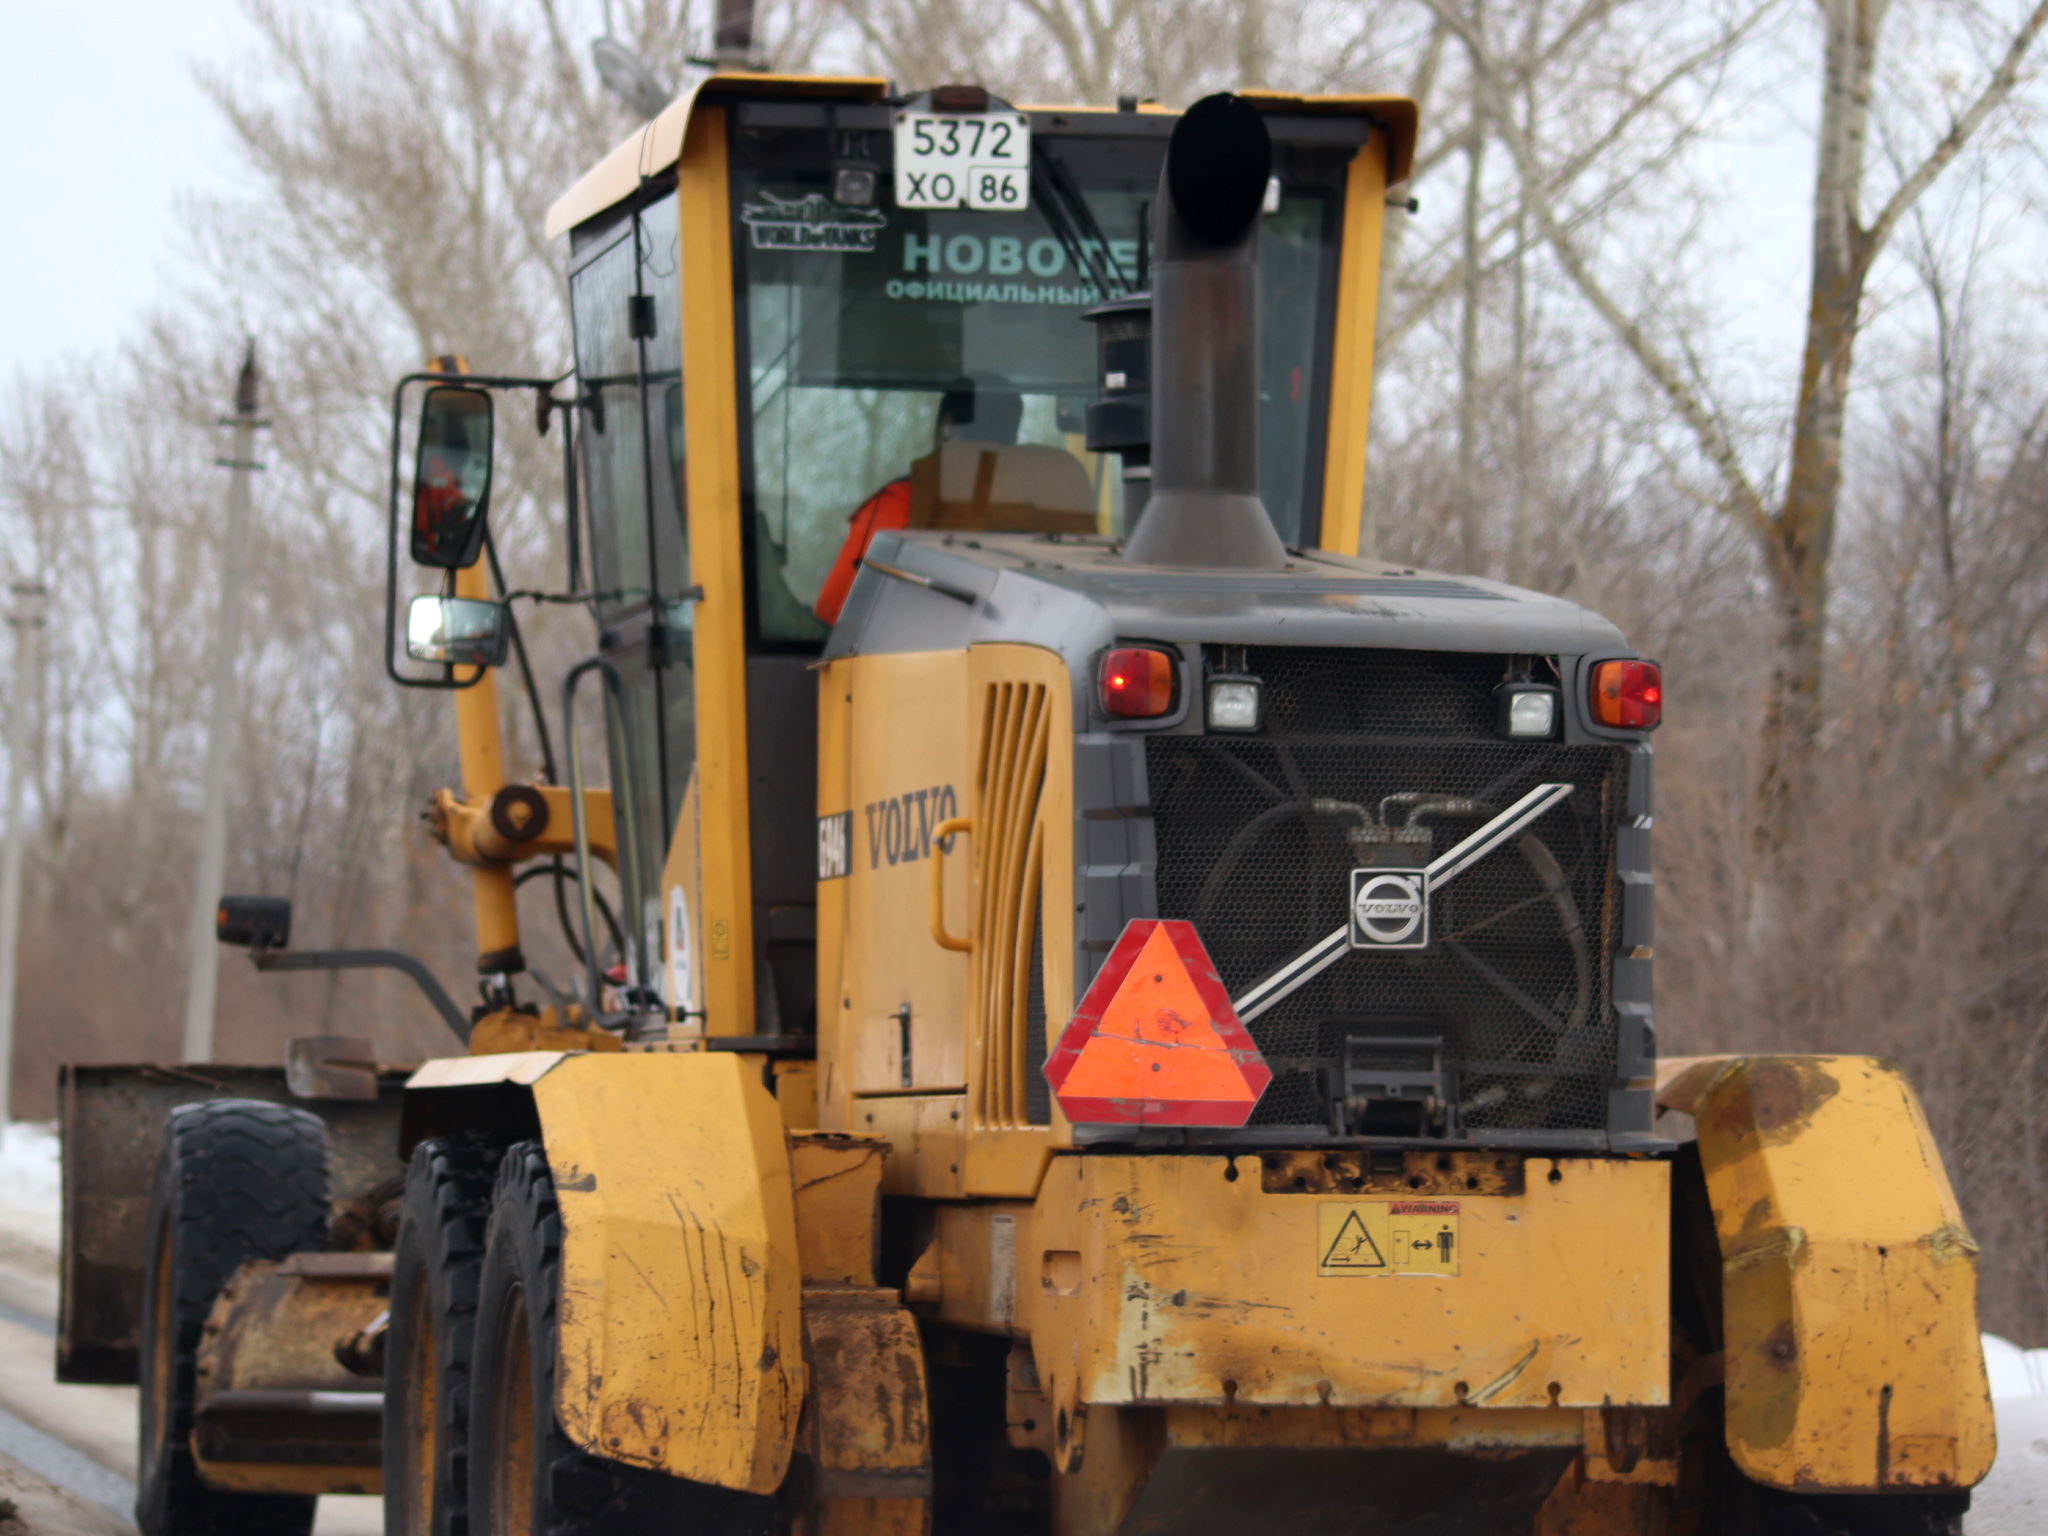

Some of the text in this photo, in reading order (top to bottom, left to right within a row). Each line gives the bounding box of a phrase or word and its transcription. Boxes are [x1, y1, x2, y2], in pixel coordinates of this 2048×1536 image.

[914, 119, 1012, 158] 5372
[979, 174, 1018, 203] 86
[886, 279, 1099, 305] ОФИЦИАЛЬНЫЙ
[865, 784, 957, 870] VOLVO
[1358, 903, 1419, 914] VOLVO
[1401, 1203, 1459, 1214] WARNING
